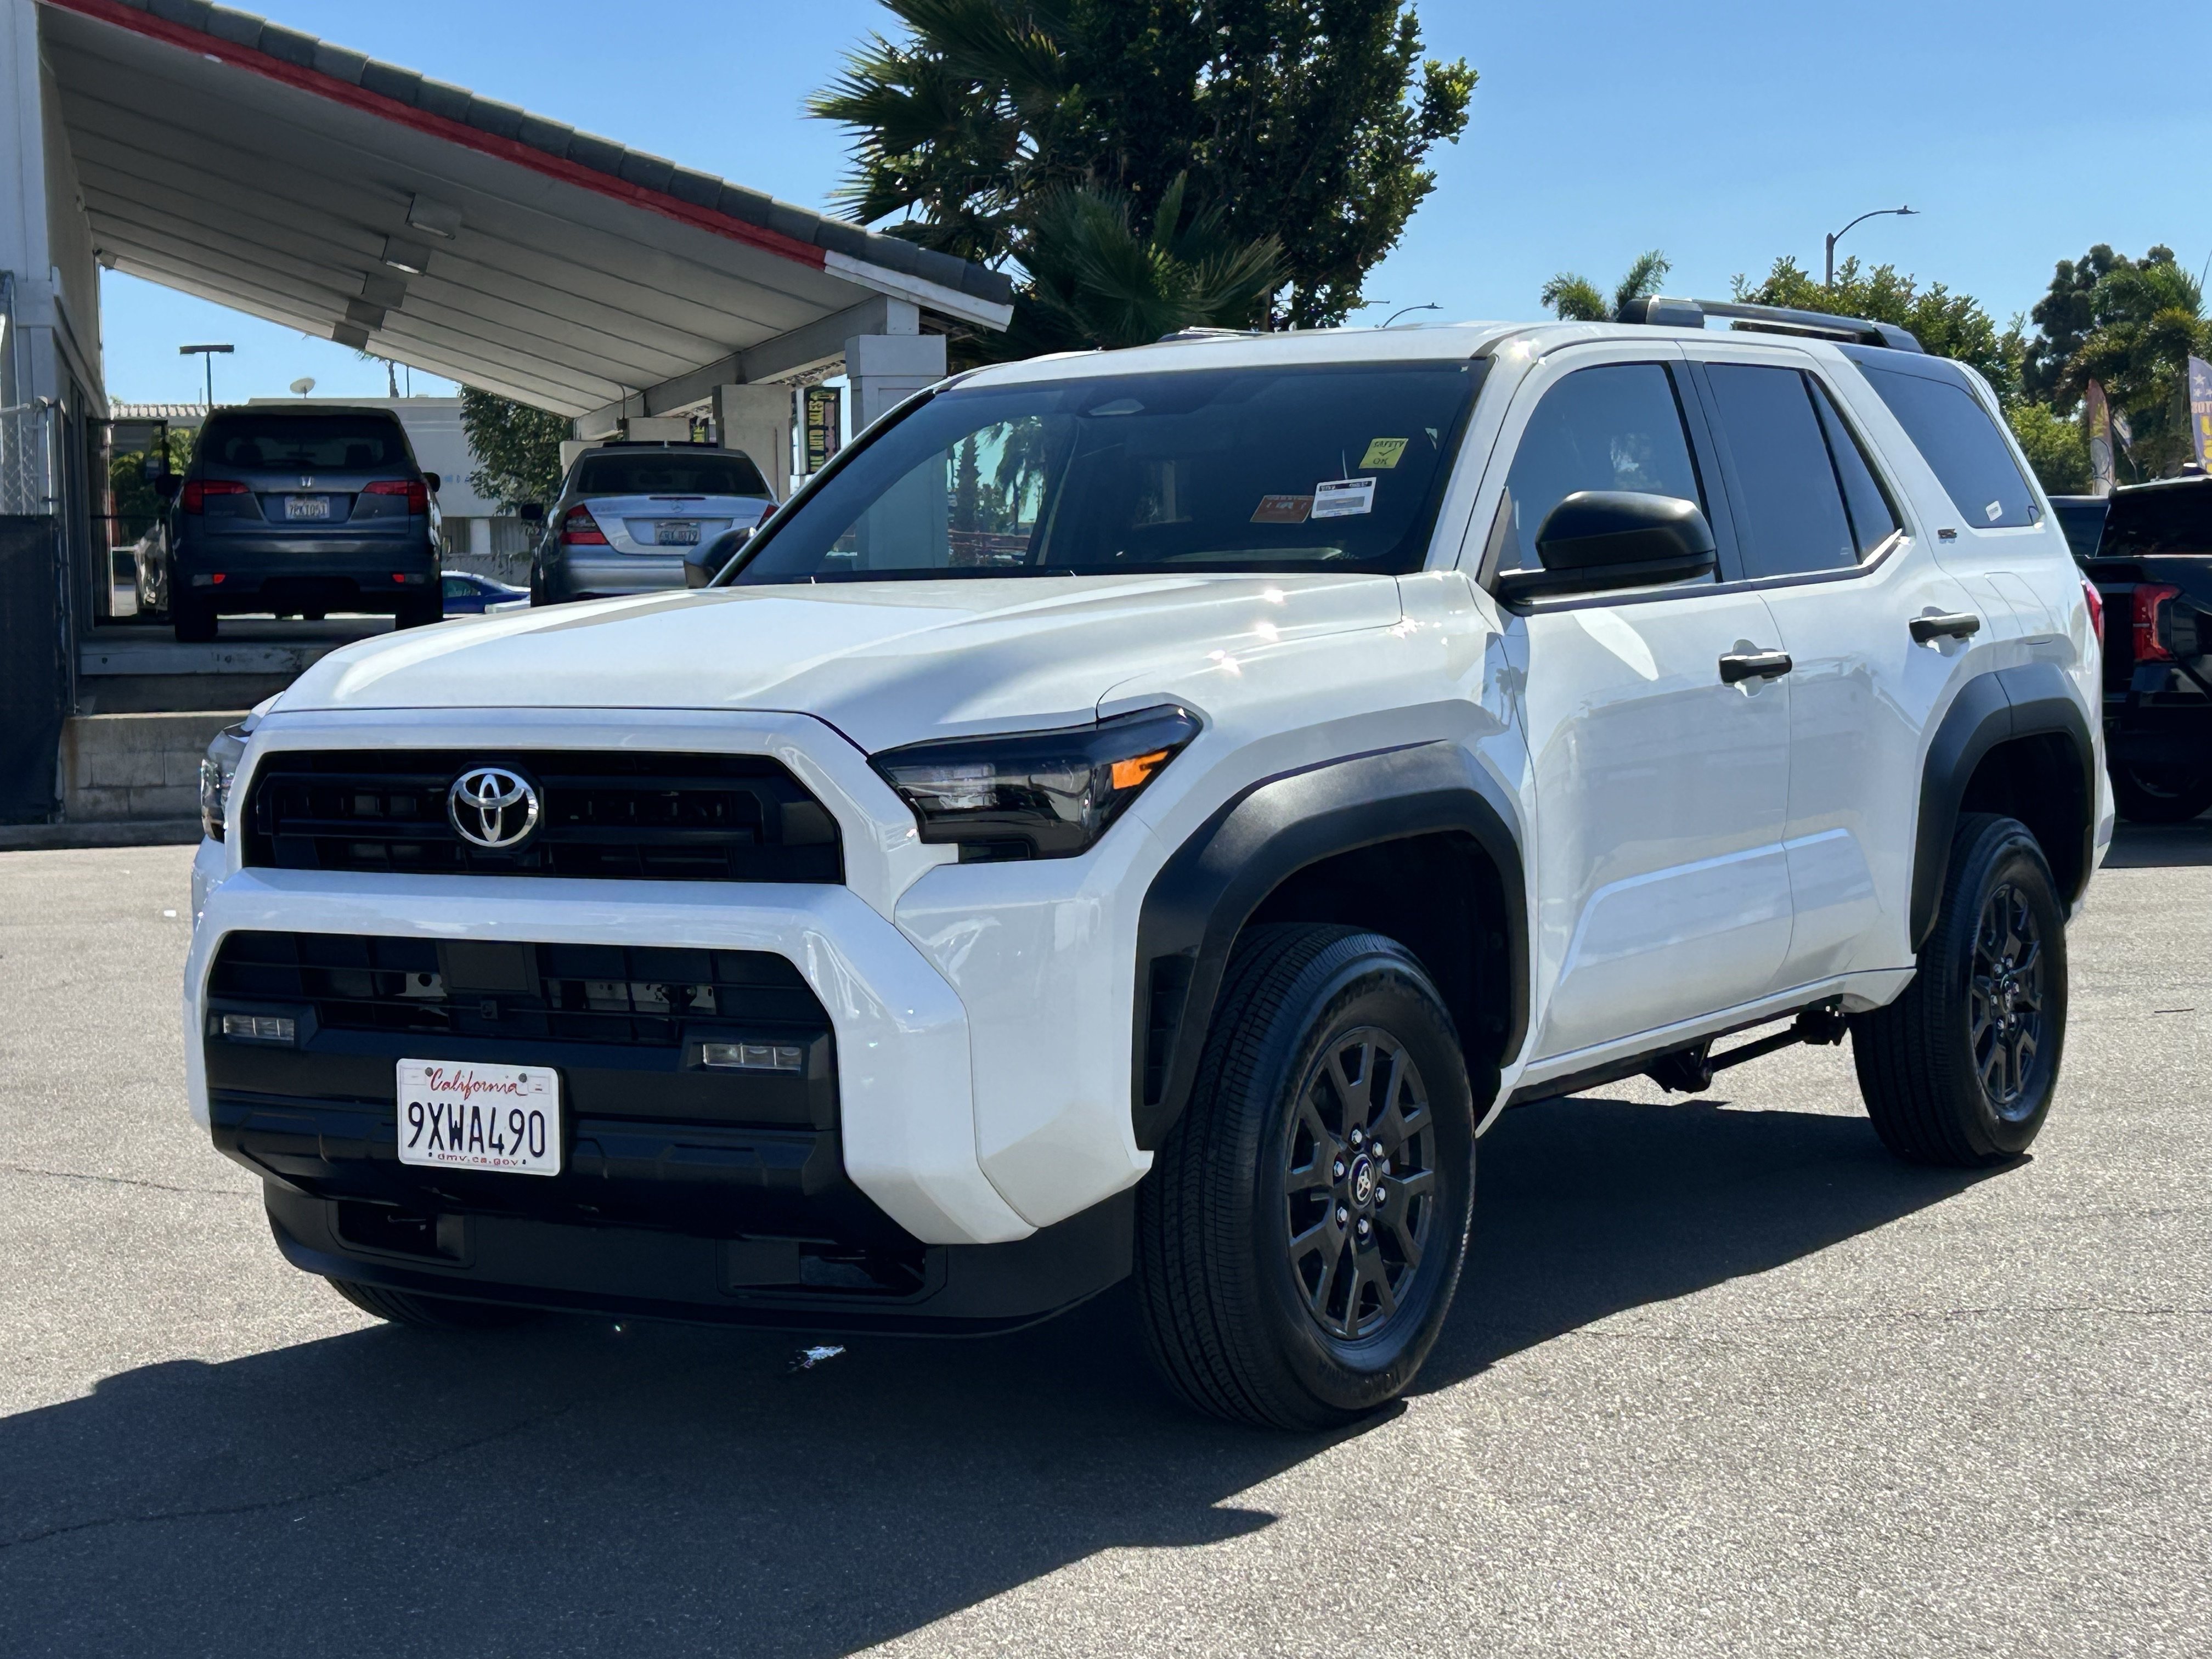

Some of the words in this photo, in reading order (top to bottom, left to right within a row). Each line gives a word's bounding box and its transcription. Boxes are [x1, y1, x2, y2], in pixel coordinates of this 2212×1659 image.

[430, 1067, 529, 1100] California
[408, 1101, 545, 1158] 9XWA490
[437, 1153, 519, 1166] dmv.ca.gov
